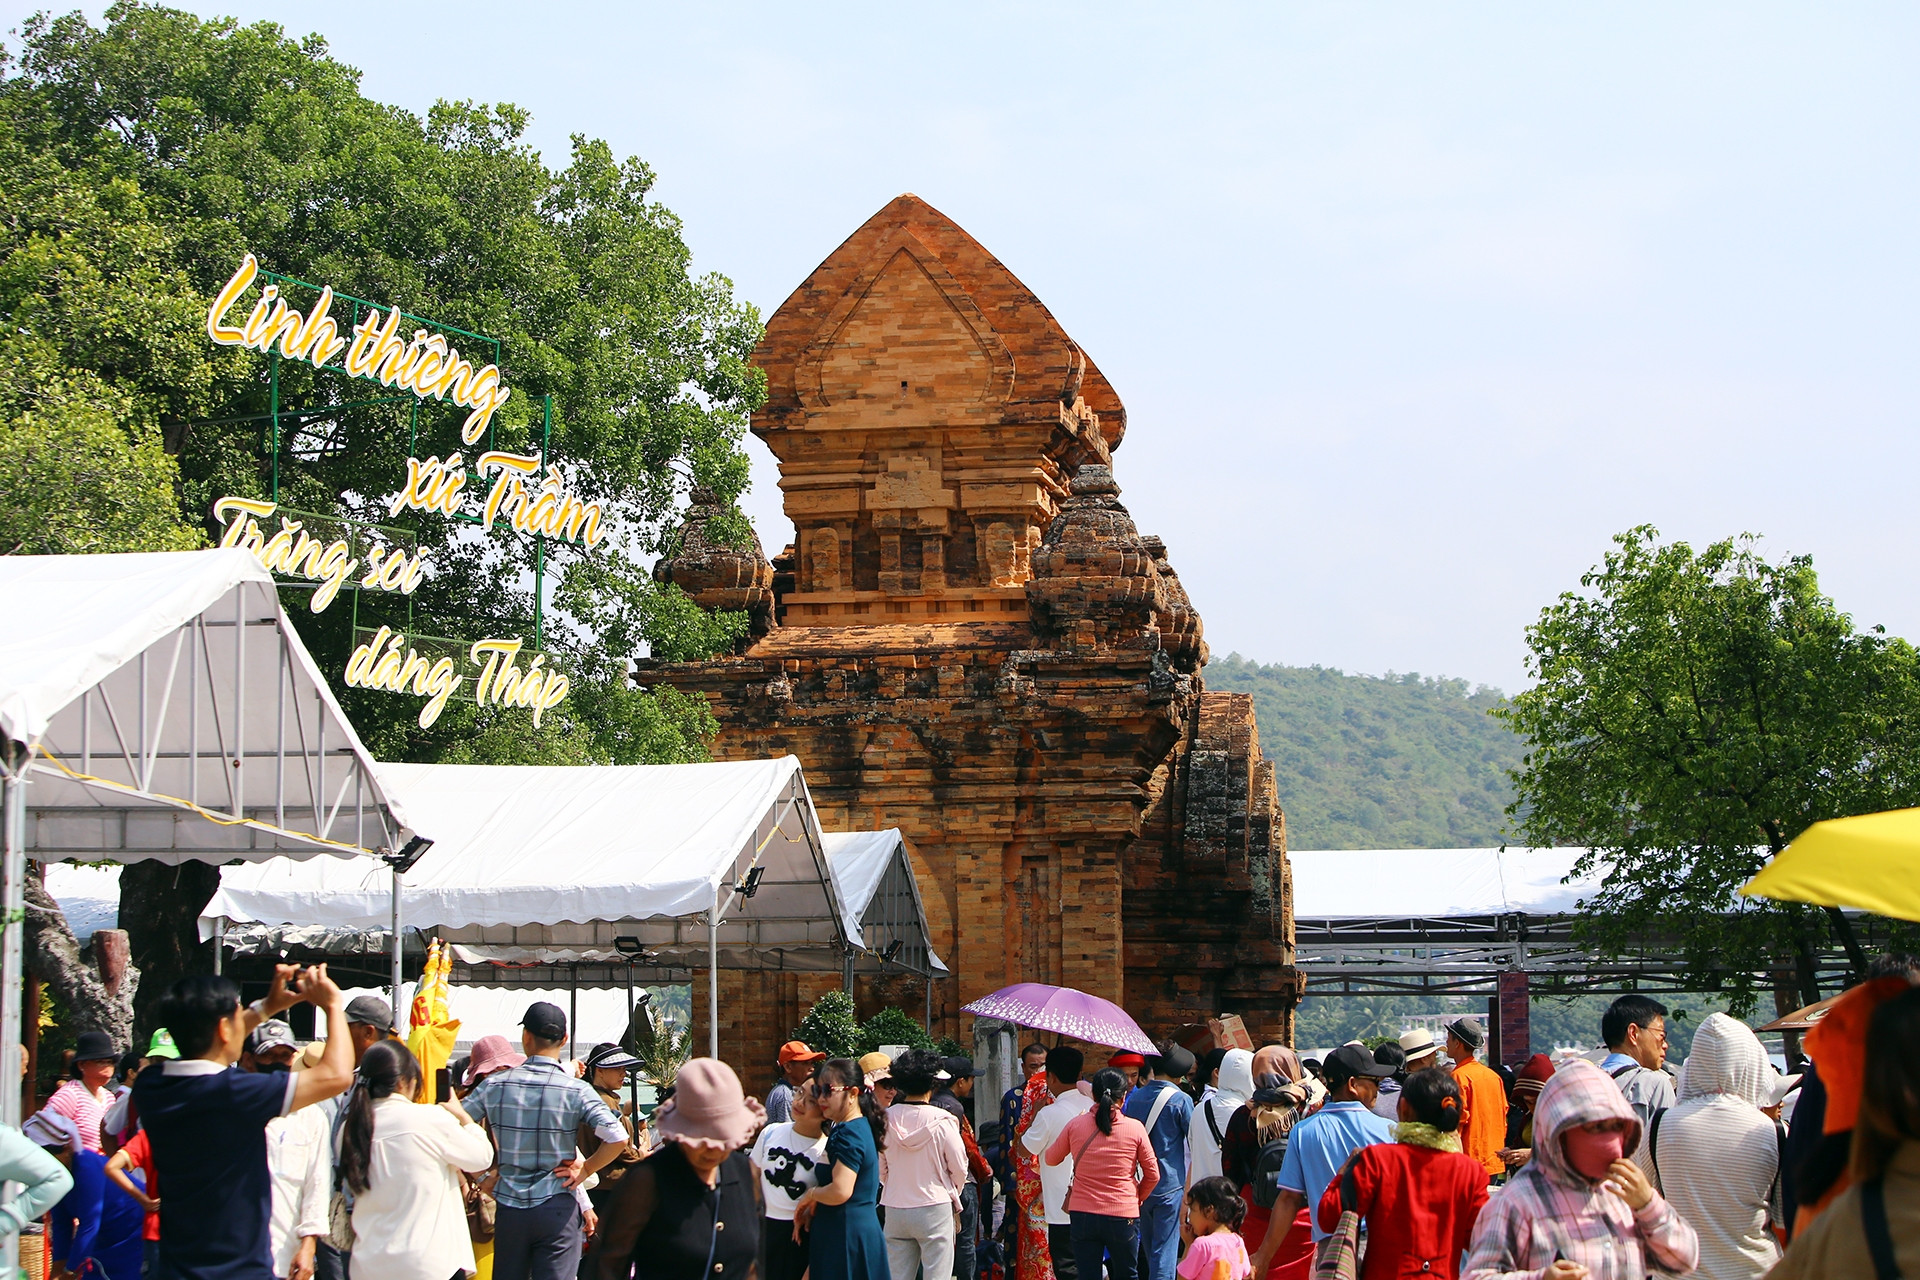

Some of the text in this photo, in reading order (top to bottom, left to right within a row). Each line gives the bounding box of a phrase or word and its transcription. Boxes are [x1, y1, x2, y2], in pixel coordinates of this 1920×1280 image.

[208, 254, 510, 446] Linh thiêng
[476, 451, 607, 549] Trầm
[213, 497, 428, 614] Trăng soi
[470, 637, 569, 729] Tháp
